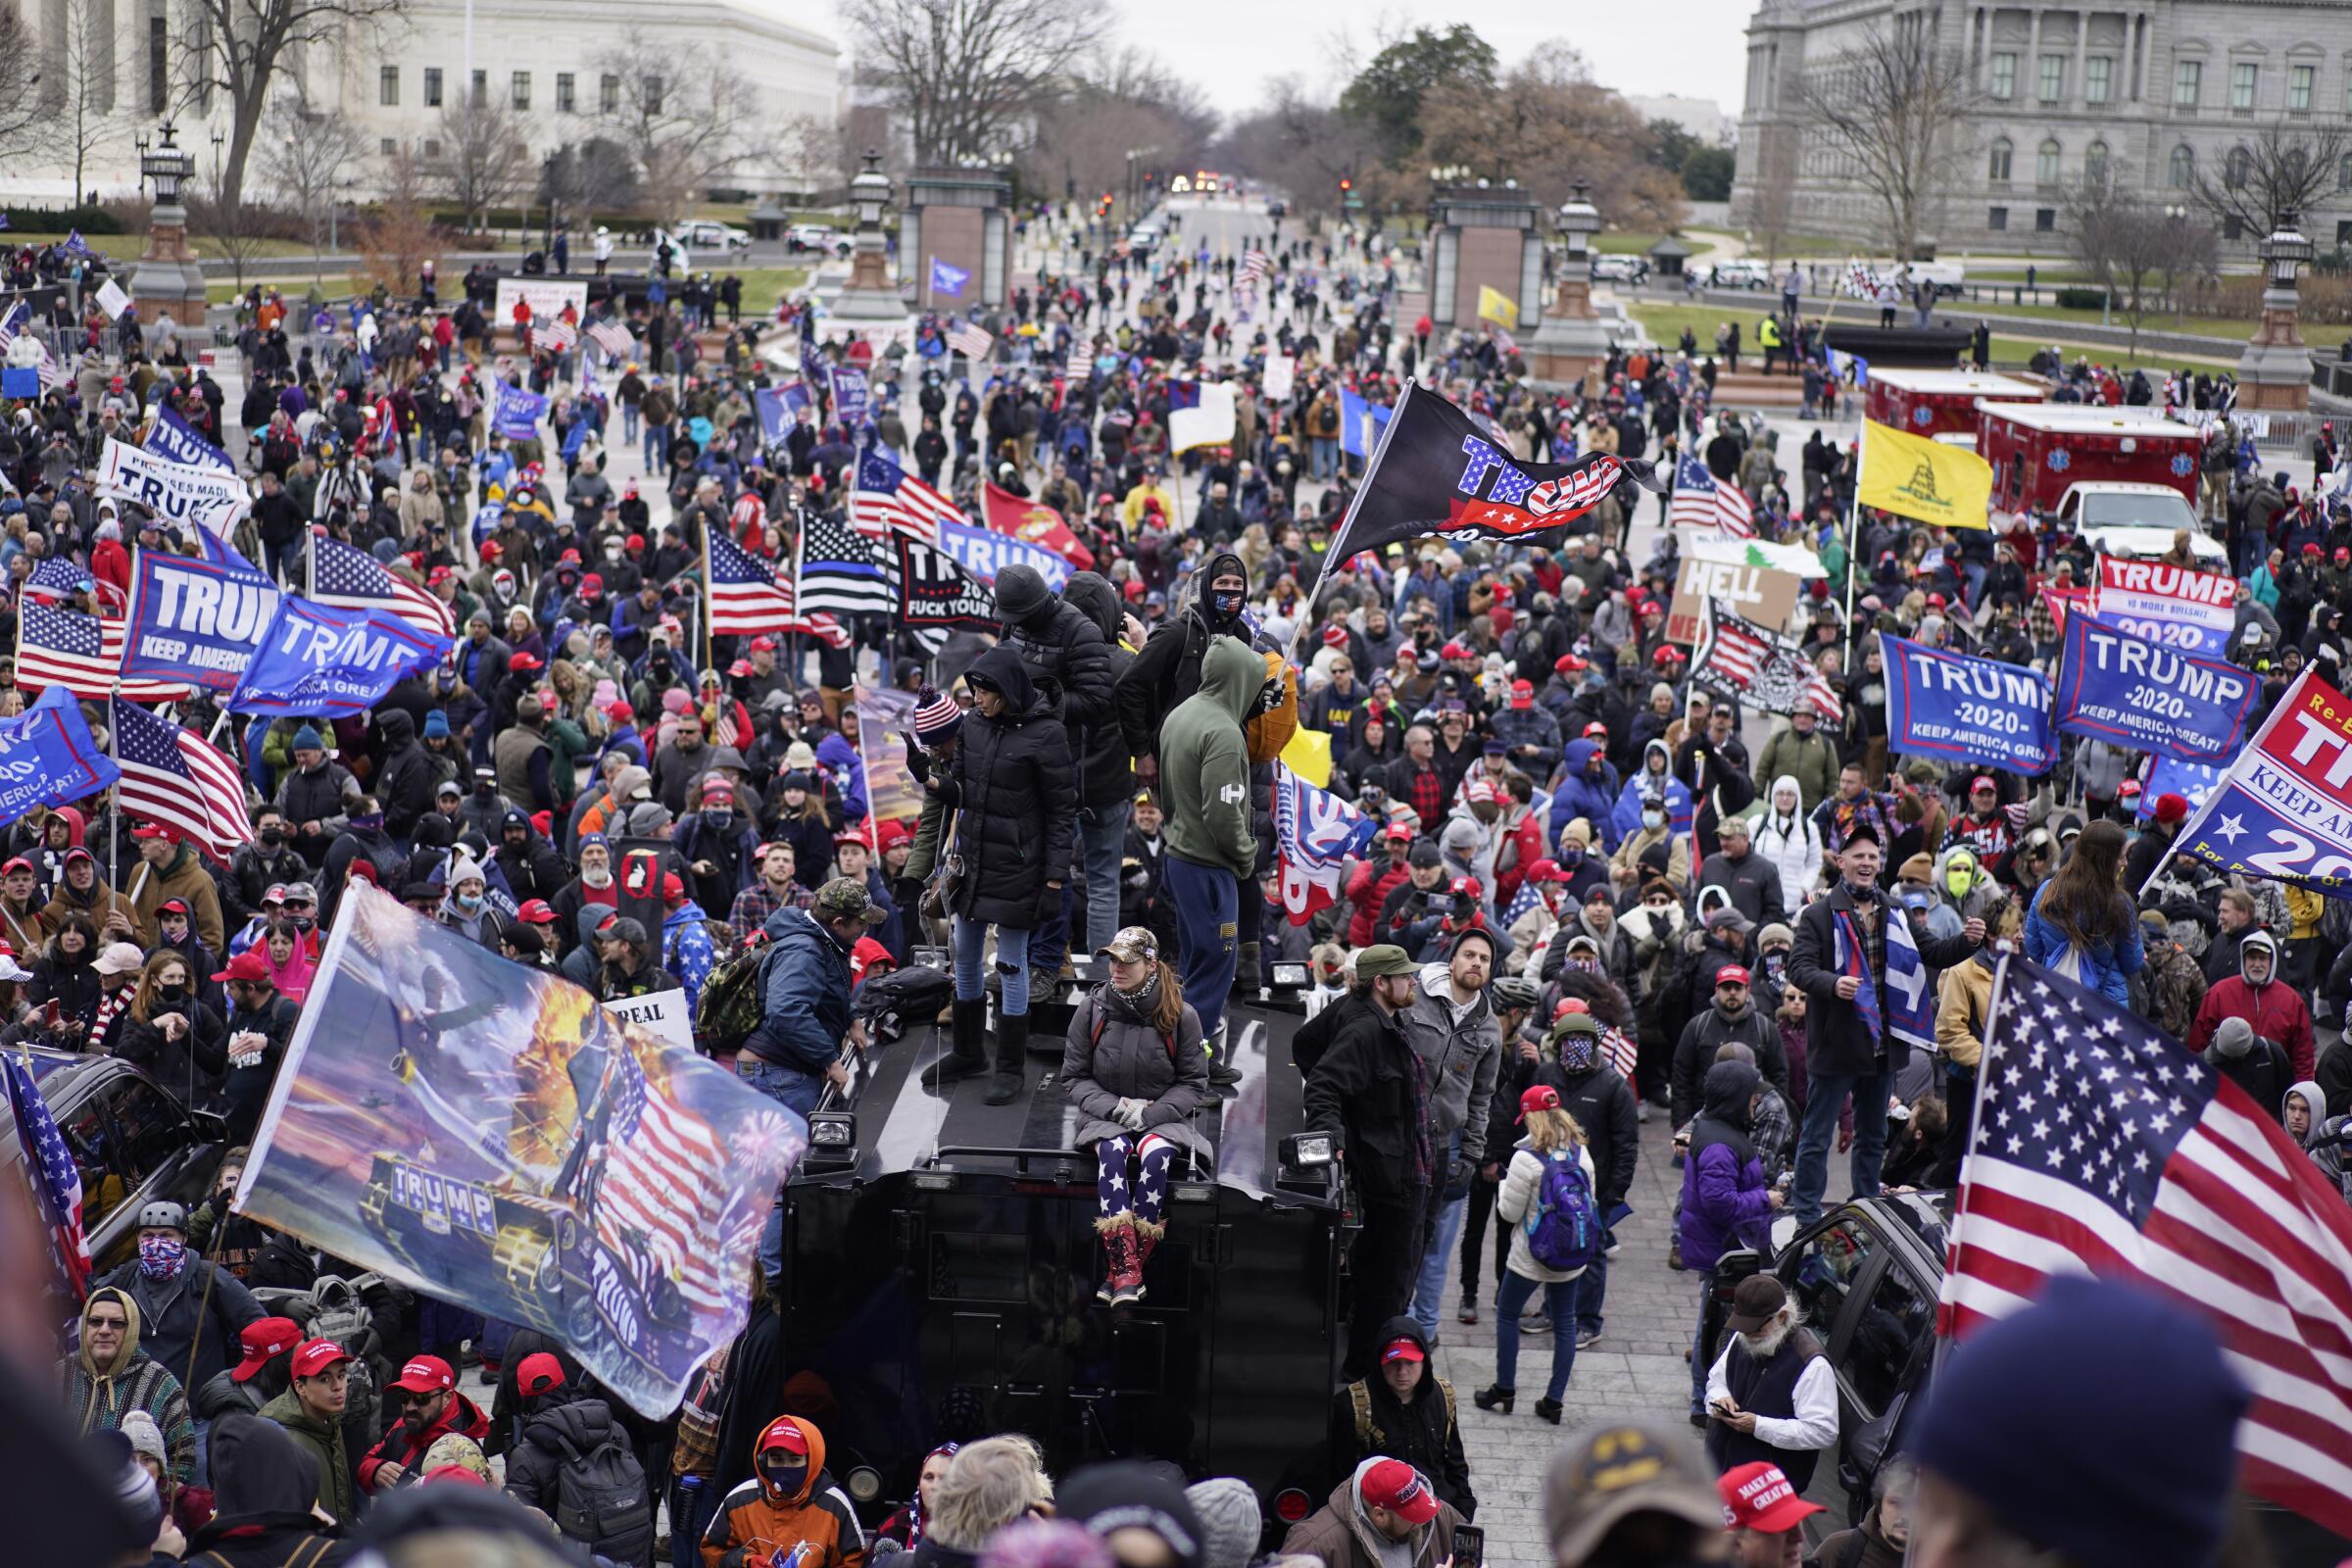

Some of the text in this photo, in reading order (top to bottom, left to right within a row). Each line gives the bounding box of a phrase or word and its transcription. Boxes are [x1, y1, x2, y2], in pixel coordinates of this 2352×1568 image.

[158, 417, 232, 473] TRUM
[1458, 434, 1623, 516] TRUMP
[1683, 561, 1763, 604] HELL
[2107, 560, 2236, 606] TRUMP
[154, 565, 279, 647] TRU
[907, 599, 991, 618] FUCK YOUR
[2140, 600, 2165, 613] MORE
[140, 635, 253, 672] KEEP AMERIC
[2089, 633, 2243, 706] TRUMP
[1953, 702, 2031, 734] -2020-
[2125, 685, 2192, 719] -2020-
[2309, 693, 2352, 736] Re-E
[1912, 722, 1951, 739] KEEP
[1951, 729, 2010, 753] AMERICA
[2079, 703, 2221, 753] KEEP AMERICA GREAT!
[2249, 763, 2322, 817] KEEP
[2194, 841, 2224, 862] For
[2322, 875, 2345, 888] Of
[2246, 829, 2352, 879] 20
[617, 1004, 664, 1024] REAL
[394, 1166, 491, 1216] TRUMP
[592, 1249, 638, 1348] TRUMP
[1738, 1474, 1768, 1500] MAKE
[1752, 1485, 1782, 1511] GREAT
